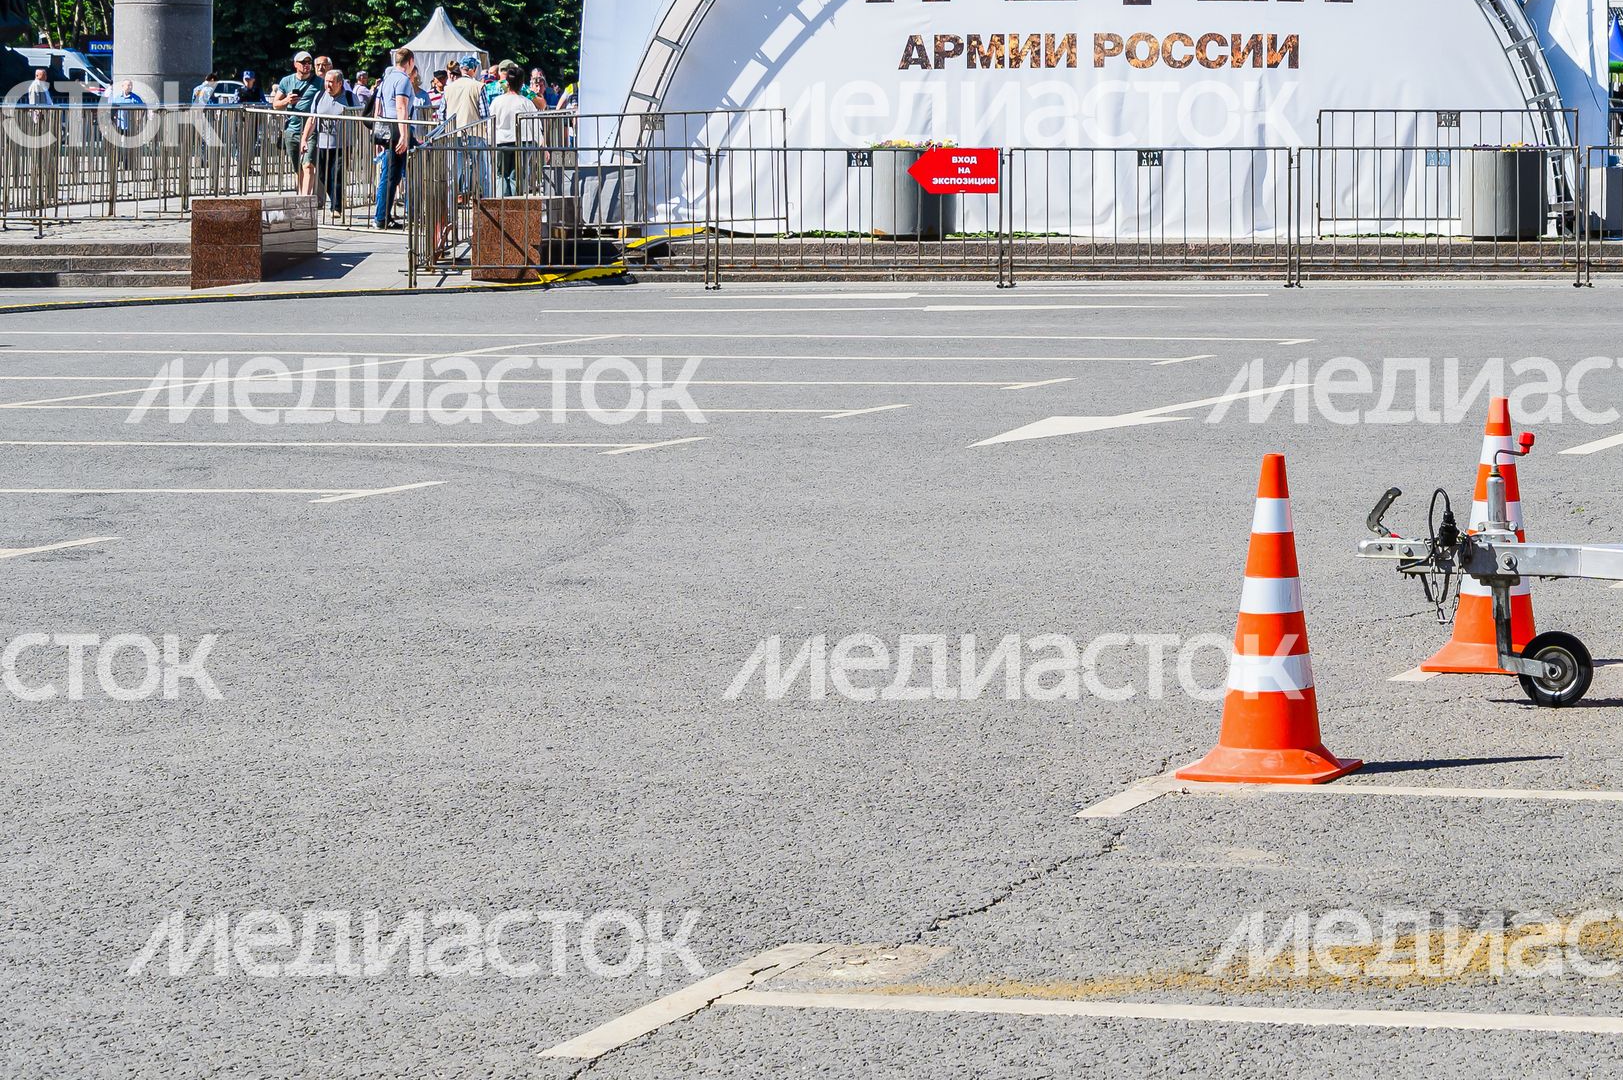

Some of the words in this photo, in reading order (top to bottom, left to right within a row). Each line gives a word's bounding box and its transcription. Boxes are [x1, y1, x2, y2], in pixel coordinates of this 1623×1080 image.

[898, 33, 1077, 70] АРМИИ
[1093, 32, 1299, 70] РОССИИ
[951, 156, 977, 164] ВХОД
[932, 177, 997, 186] ЭКСПОЗИЦИЮ
